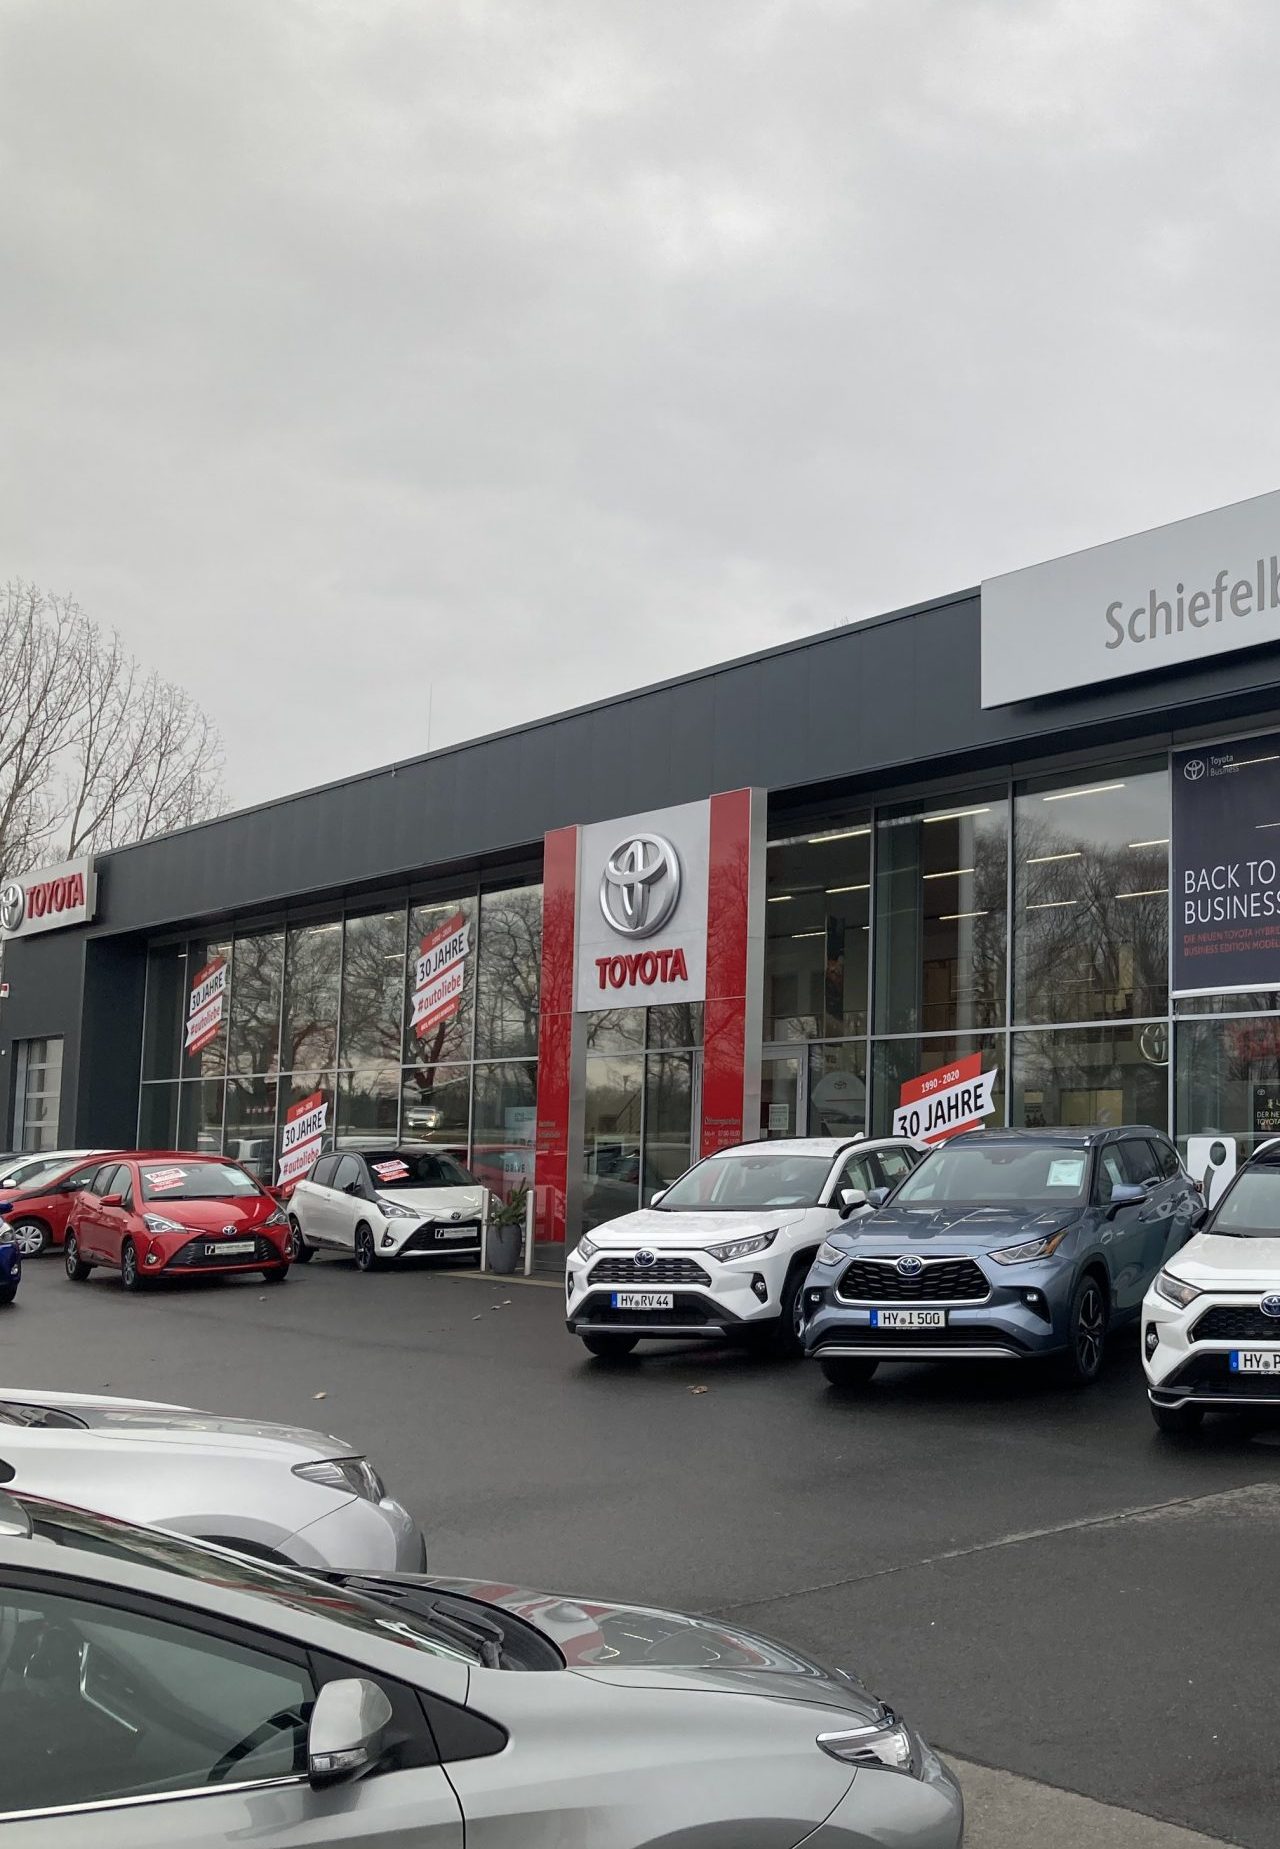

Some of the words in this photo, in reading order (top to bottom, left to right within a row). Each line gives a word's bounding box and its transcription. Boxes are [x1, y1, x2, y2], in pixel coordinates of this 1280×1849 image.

[1210, 755, 1234, 766] Toyota
[1210, 766, 1240, 777] Business
[1184, 863, 1240, 894] BACK
[1246, 859, 1276, 886] TO
[26, 872, 84, 919] TOYOTA
[419, 958, 431, 982] 30
[433, 932, 464, 973] JAHRE
[595, 947, 688, 990] TOYOTA
[191, 992, 200, 1011] 30
[201, 971, 223, 1004] JAHRE
[417, 974, 461, 1013] #autoliebe
[921, 1078, 938, 1093] 1990
[943, 1069, 960, 1085] 2020
[898, 1111, 920, 1137] 30
[924, 1082, 985, 1132] JAHRE
[285, 1127, 296, 1147] 30
[296, 1111, 322, 1141] JAHRE
[283, 1147, 320, 1174] #autoliebe
[620, 1295, 634, 1307] HY
[640, 1295, 655, 1307] RV
[656, 1295, 669, 1307] 44
[883, 1312, 899, 1325] HY
[917, 1312, 941, 1325] 500
[1243, 1353, 1262, 1369] HY
